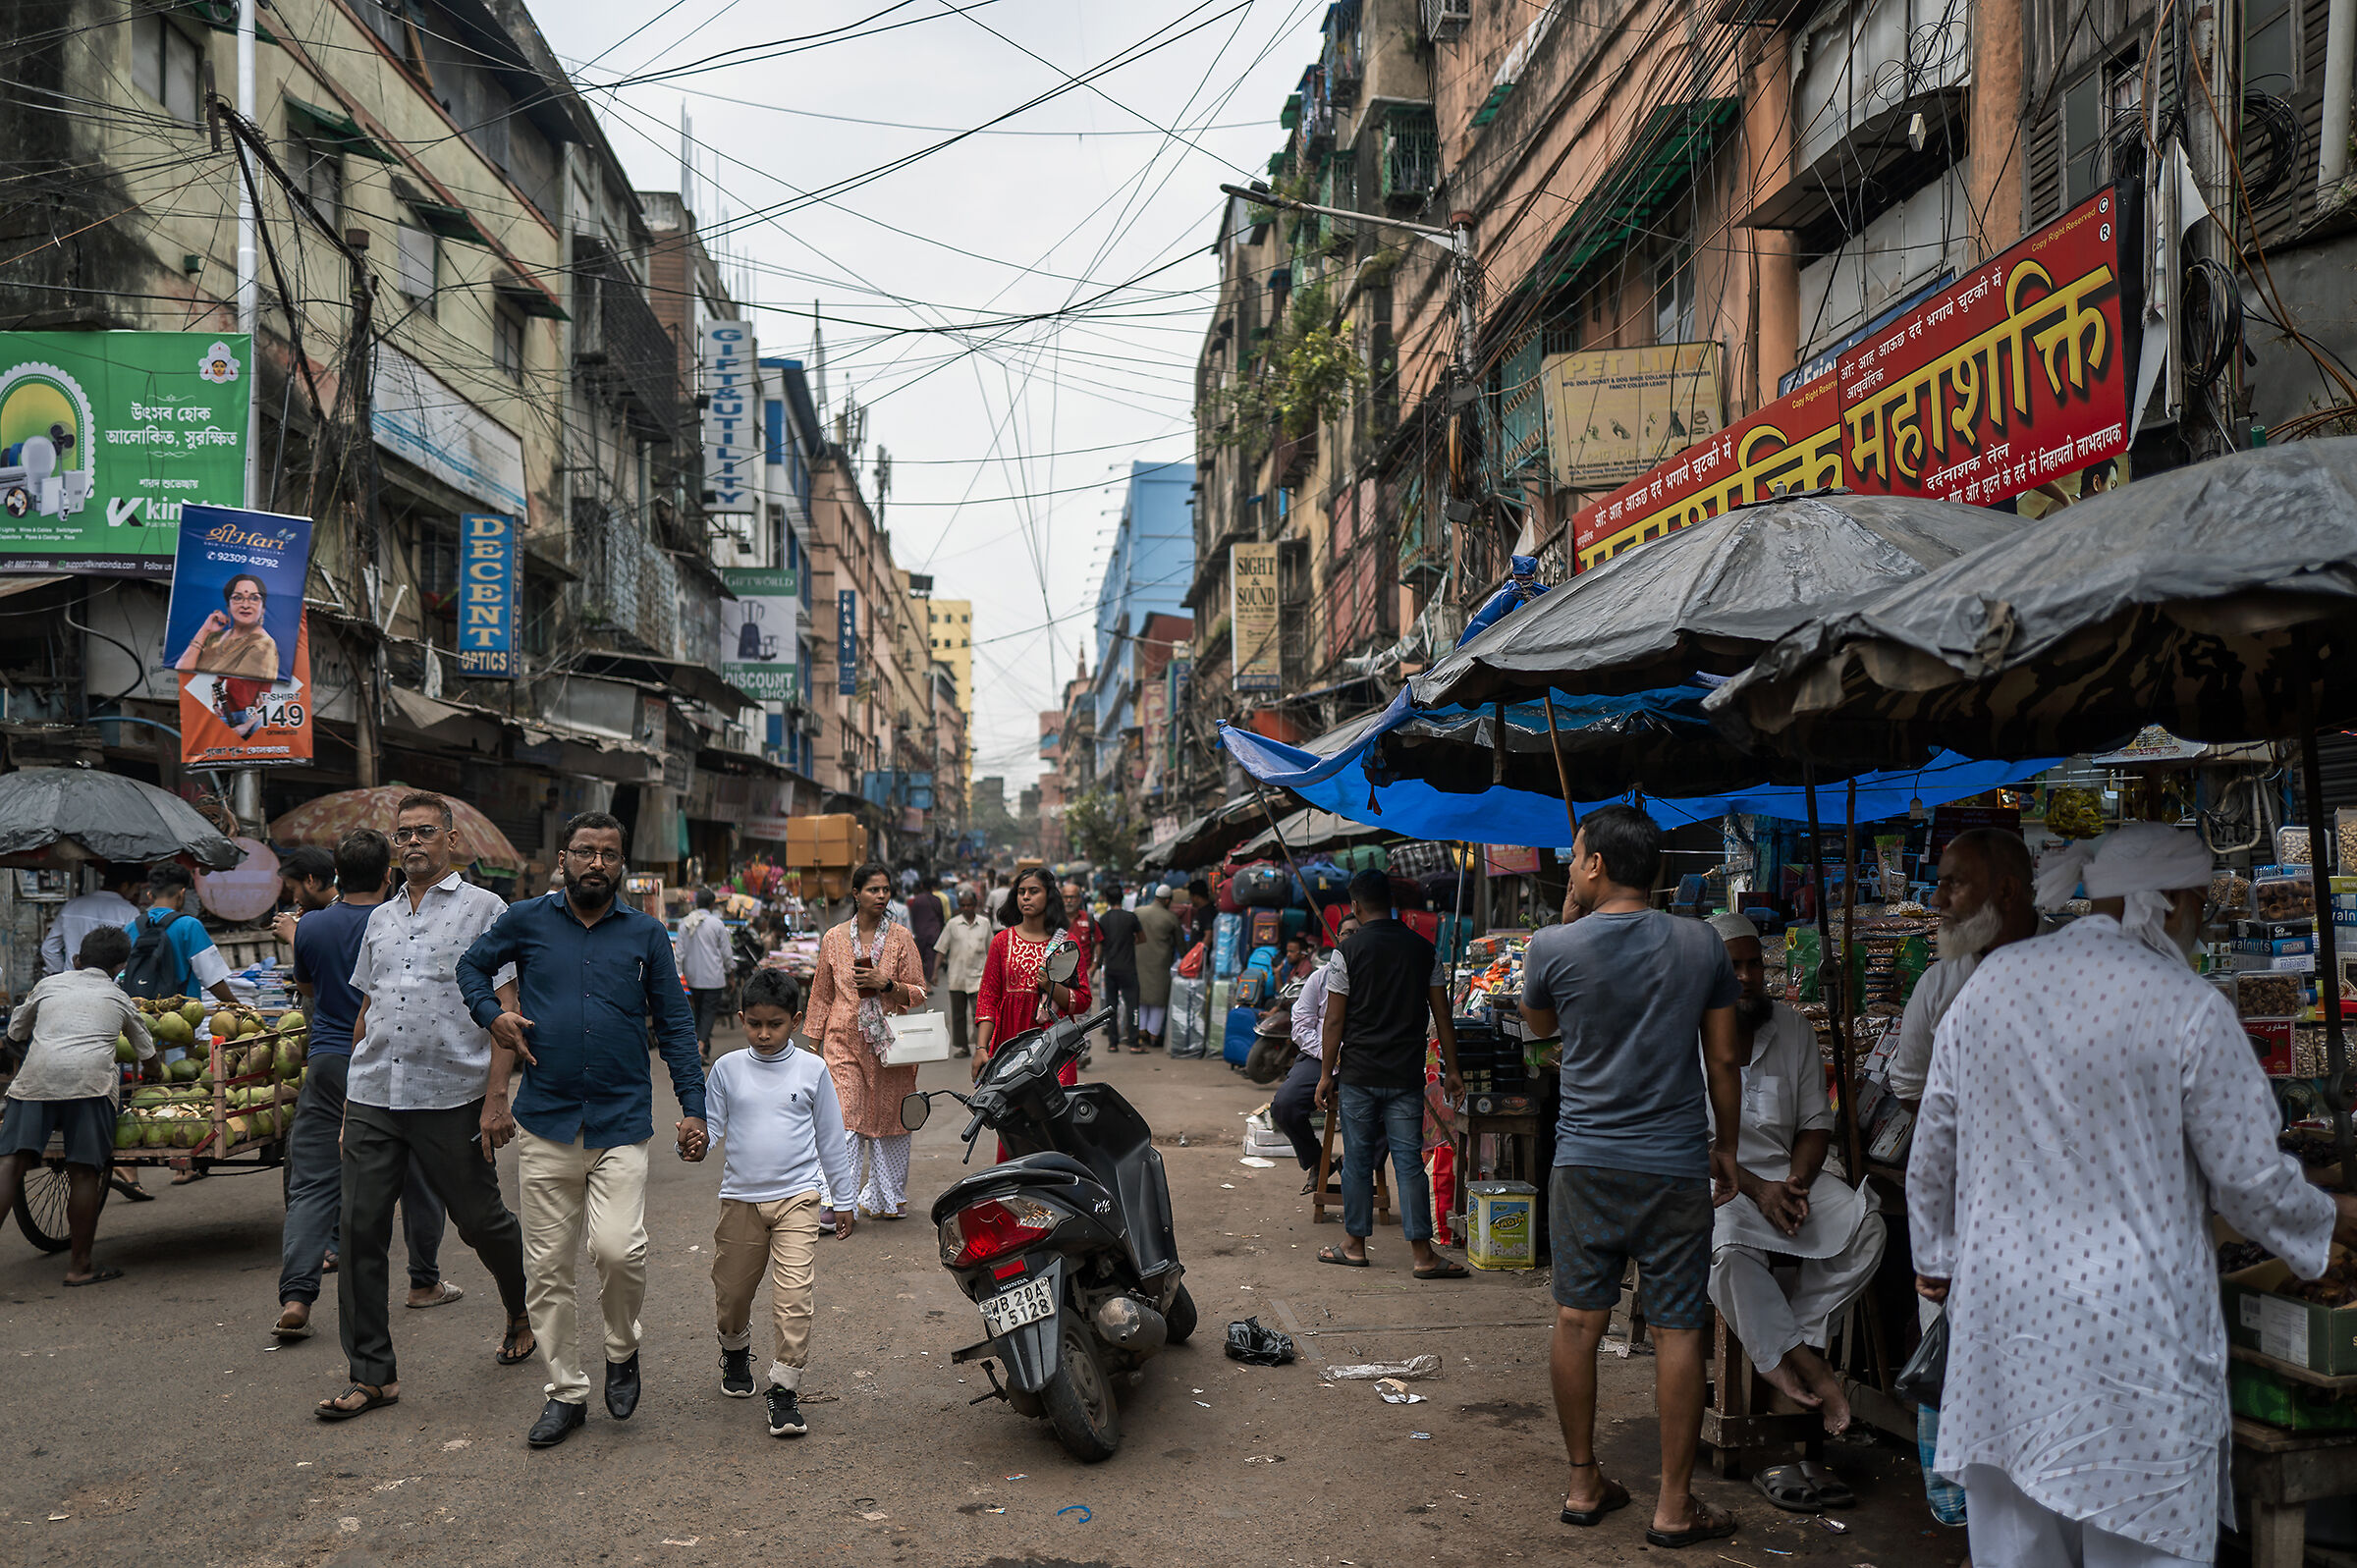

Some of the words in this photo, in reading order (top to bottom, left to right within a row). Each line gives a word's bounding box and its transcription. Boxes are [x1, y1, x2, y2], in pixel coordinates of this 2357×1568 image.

[2031, 238, 2048, 251] Copy
[2048, 226, 2065, 243] Right
[2065, 207, 2096, 232] Reserved
[1908, 314, 1923, 340] दर्द
[1926, 297, 1954, 326] भगाये
[1957, 275, 1989, 313] चुटकी
[1992, 266, 2002, 287] में
[1563, 354, 1621, 379] PET
[1843, 259, 2113, 482] महाशक्ति
[1791, 397, 1805, 409] Copy
[1805, 387, 1819, 403] Right
[131, 401, 173, 421] উৎসব
[177, 406, 212, 423] হোক
[105, 424, 180, 447] আলোকিত,
[184, 425, 238, 449] সুরক্ষিত
[1650, 471, 1663, 503] दर्द
[1666, 458, 1690, 490] भगाये
[1693, 441, 1720, 482] चुटकी
[1722, 433, 1732, 460] में
[1926, 455, 1982, 491] दर्दनाशक
[1986, 442, 2010, 464] तेल
[1965, 477, 1980, 503] और
[2002, 463, 2011, 487] के
[2014, 457, 2027, 484] दर्द
[2076, 422, 2122, 458] लाभदायक
[143, 561, 163, 569] Follow
[217, 552, 247, 564] 92309
[248, 556, 279, 568] 42792
[1237, 557, 1275, 575] SIGHT
[467, 517, 506, 647] DECENT
[1237, 587, 1276, 605] SOUND
[461, 651, 507, 672] OPTICS
[725, 673, 794, 688] DISCOUNT
[261, 692, 301, 701] T-SHIRT
[759, 689, 795, 699] SHOP
[999, 1277, 1029, 1292] HONDA
[1014, 1282, 1044, 1307] 20A
[1008, 1298, 1050, 1325] 5128
